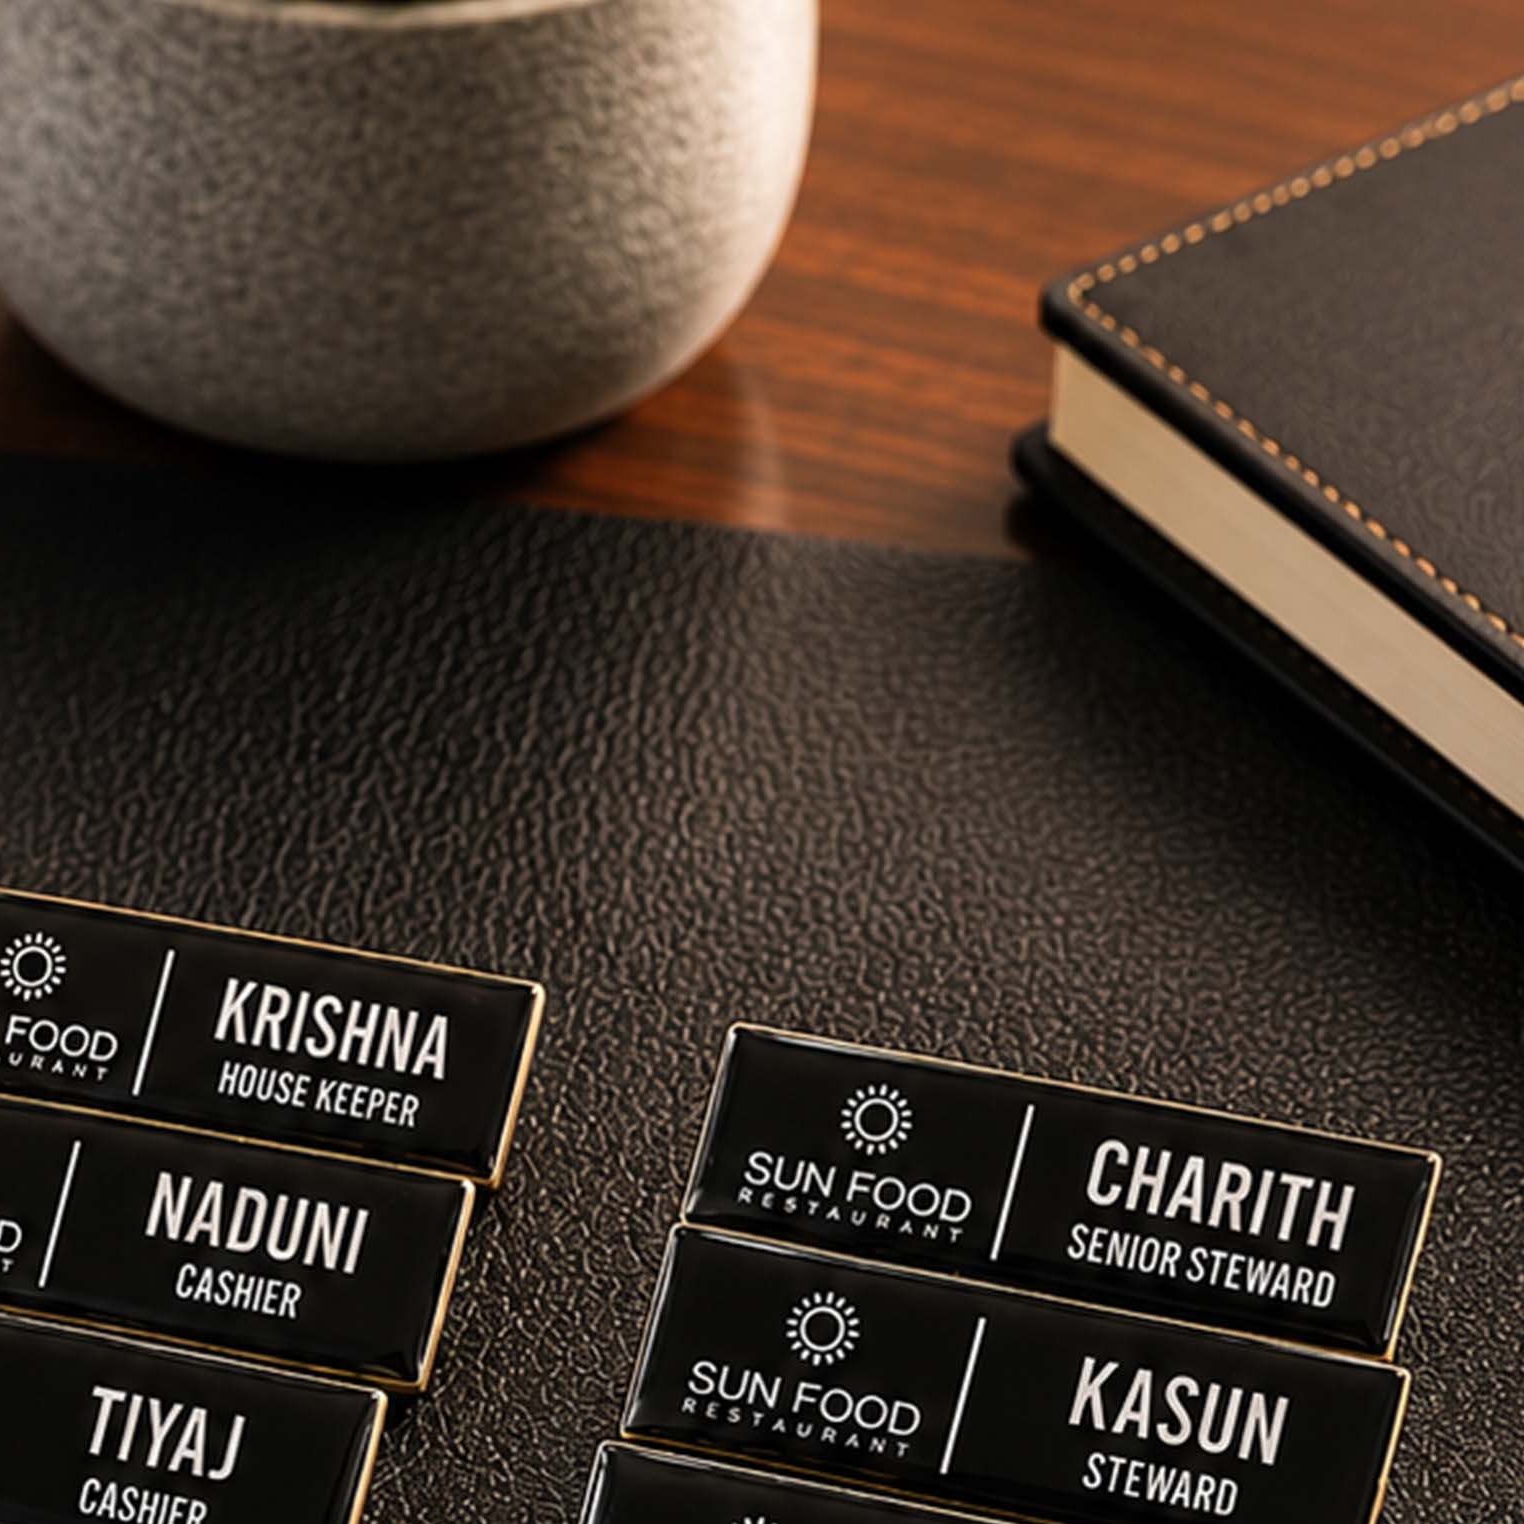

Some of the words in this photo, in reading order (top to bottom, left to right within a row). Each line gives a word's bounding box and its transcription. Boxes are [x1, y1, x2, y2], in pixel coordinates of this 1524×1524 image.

[5, 1015, 118, 1062] FOOD
[214, 978, 448, 1080] KRISHNA
[218, 1060, 309, 1108] HOUSE
[315, 1079, 419, 1127] KEEPER
[145, 1171, 369, 1274] NADUNI
[737, 1187, 964, 1244] RESTAURANT
[743, 1152, 836, 1198] SUN
[846, 1172, 970, 1222] FOOD
[1086, 1139, 1355, 1252] CHARITH
[175, 1264, 302, 1318] CASHIER
[1067, 1224, 1182, 1279] SENIOR
[1185, 1248, 1336, 1308] STEWARD
[88, 1386, 246, 1481] TIYAJ
[682, 1397, 912, 1457] RESTAURANT
[687, 1361, 782, 1409] SUN
[792, 1383, 921, 1436] FOOD
[1069, 1357, 1288, 1466] KASUN
[1082, 1452, 1239, 1518] STEWARD
